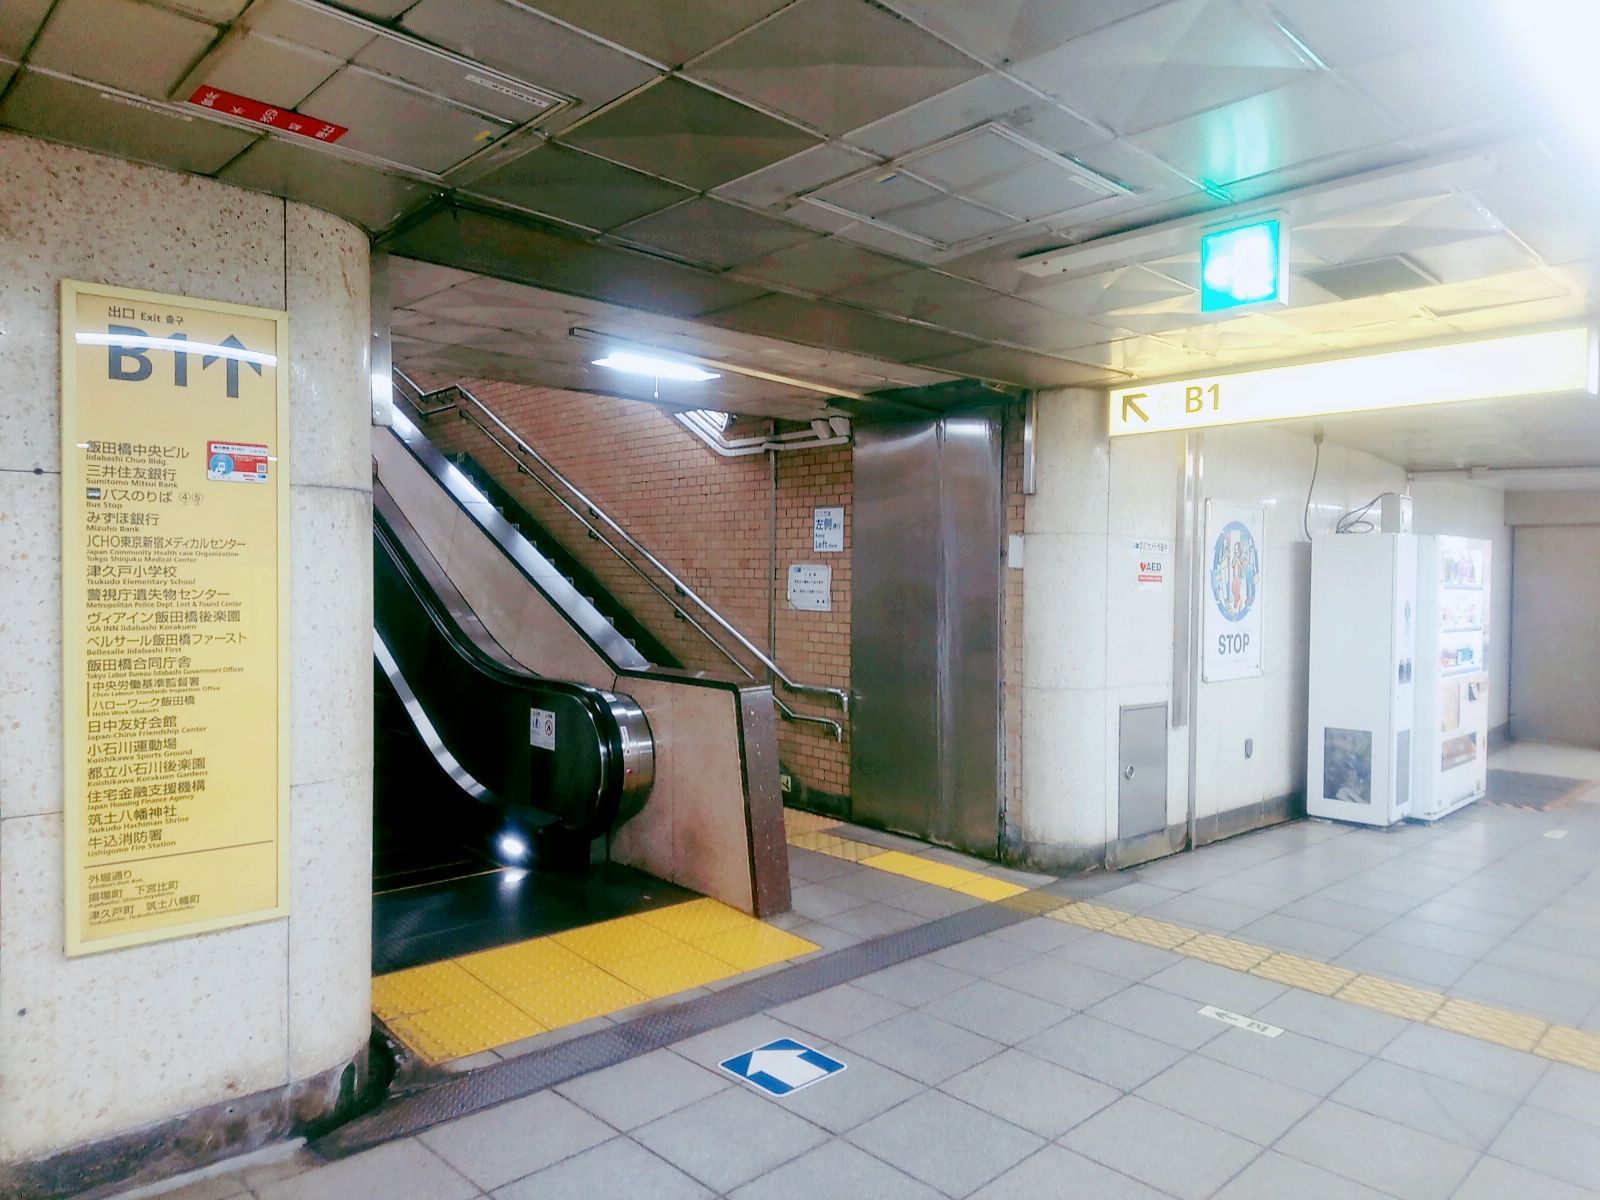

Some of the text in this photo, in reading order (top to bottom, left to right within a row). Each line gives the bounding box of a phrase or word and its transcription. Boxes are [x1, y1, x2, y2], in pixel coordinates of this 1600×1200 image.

[108, 306, 135, 320] 出口
[140, 313, 161, 323] Exit
[108, 324, 188, 387] B1
[1185, 383, 1219, 413] B1
[86, 440, 190, 459] 飯田橋中央ビル
[86, 454, 169, 467] Iidabashi Chuo Bldg.
[86, 464, 176, 482] 三井住友銀行
[86, 477, 178, 489] Sumitomo Mitsui Bank
[102, 488, 173, 503] バスのりば
[86, 501, 123, 510] Bus Stop
[86, 511, 160, 526] みずほ銀行
[119, 525, 139, 533] Bank
[86, 534, 246, 550] JCHO東京新宿メディカルセンター
[815, 540, 828, 549] Left
[110, 549, 152, 557] Community
[195, 550, 240, 558] Organization
[86, 565, 177, 578] 津久戸小学校
[1146, 562, 1162, 571] AED
[122, 578, 168, 587] Elementary
[86, 588, 230, 601] 警視庁遺失物センター
[86, 601, 133, 609] Metropolitan
[156, 601, 174, 609] Dept.
[87, 610, 241, 624] ヴィアイン飯田橋後楽園
[121, 624, 157, 632] Iidabashi
[87, 632, 247, 648] ベルサール飯田橋ファースト
[1218, 633, 1250, 655] STOP
[86, 648, 125, 656] Bellesalle
[86, 656, 192, 672] 飯田橋合同庁舎
[183, 667, 222, 675] Government
[92, 677, 200, 692] 中央労働基準監督署
[169, 687, 201, 695] Inspection
[92, 695, 196, 711] ハローワーク飯田橋
[88, 715, 177, 733] 日中友好会館
[87, 725, 207, 741] Japan-China Friendship Center
[87, 737, 177, 757] 小石川運動場
[87, 749, 193, 764] Koishikawa Sports Ground
[87, 757, 206, 780] 都立小石川後楽園
[87, 770, 208, 787] Koishikawa Korakuen Gardens
[87, 779, 206, 803] 住宅金融支援機構
[87, 794, 195, 812] Japan Housing Finance Agency
[87, 805, 178, 827] 筑土八幡神社
[88, 816, 190, 834] Tsukudo Hachiman Shrine
[87, 829, 163, 850] 牛込消防署
[87, 840, 177, 858] Ushigome Fire Station
[88, 870, 132, 885] 外堀通り
[134, 880, 179, 896] 下宮比町
[88, 894, 201, 921] 津久戸町 筑土八幡町
